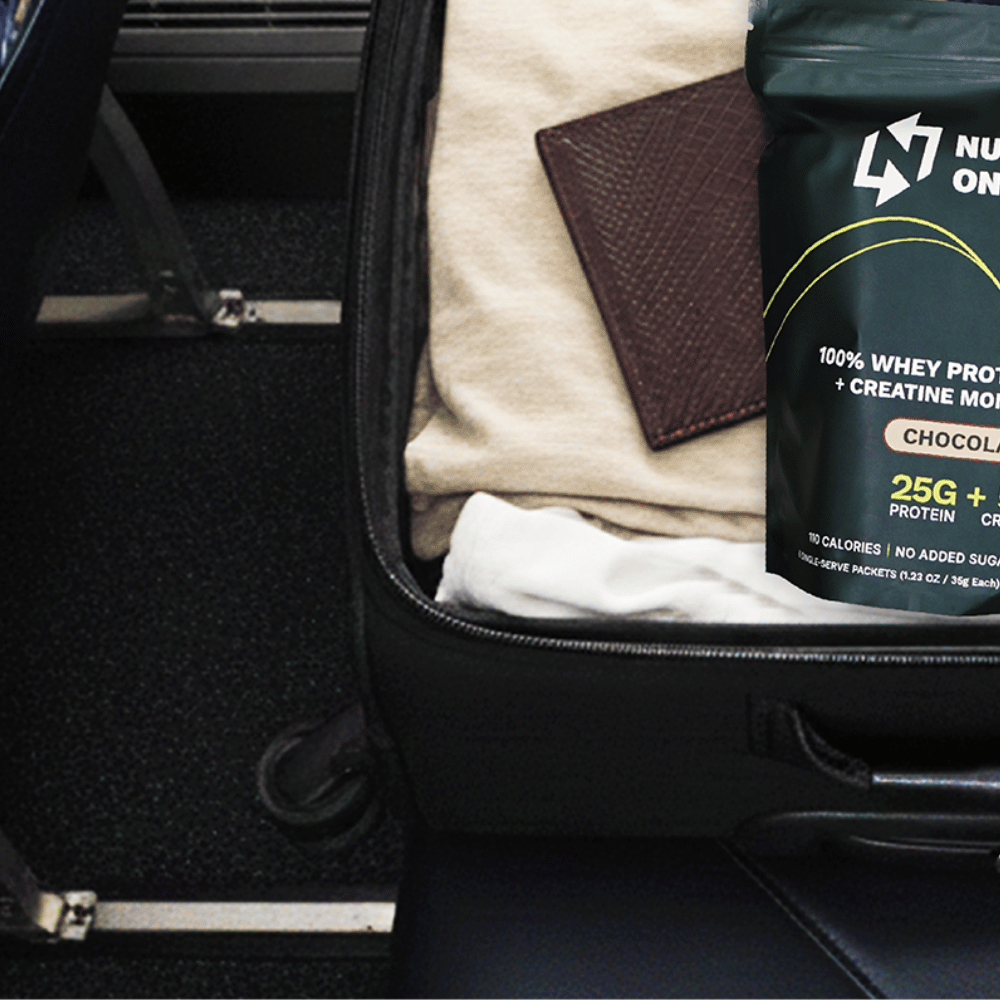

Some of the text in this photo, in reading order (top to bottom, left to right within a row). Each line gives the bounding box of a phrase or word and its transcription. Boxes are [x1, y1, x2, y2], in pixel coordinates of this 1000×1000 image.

[952, 168, 1000, 196] ON
[818, 345, 866, 371] 100%
[871, 352, 941, 379] WHEY
[849, 377, 954, 406] CREATINE
[890, 473, 957, 506] 25G
[967, 488, 986, 508] +
[889, 502, 956, 523] PROTEIN
[822, 535, 882, 556] CALORIES
[894, 546, 916, 559] NO
[918, 549, 966, 564] ADDED
[852, 562, 896, 580] PACKETS
[900, 570, 922, 582] (1.23
[926, 574, 940, 584] OZ
[972, 577, 1000, 590] Each)
